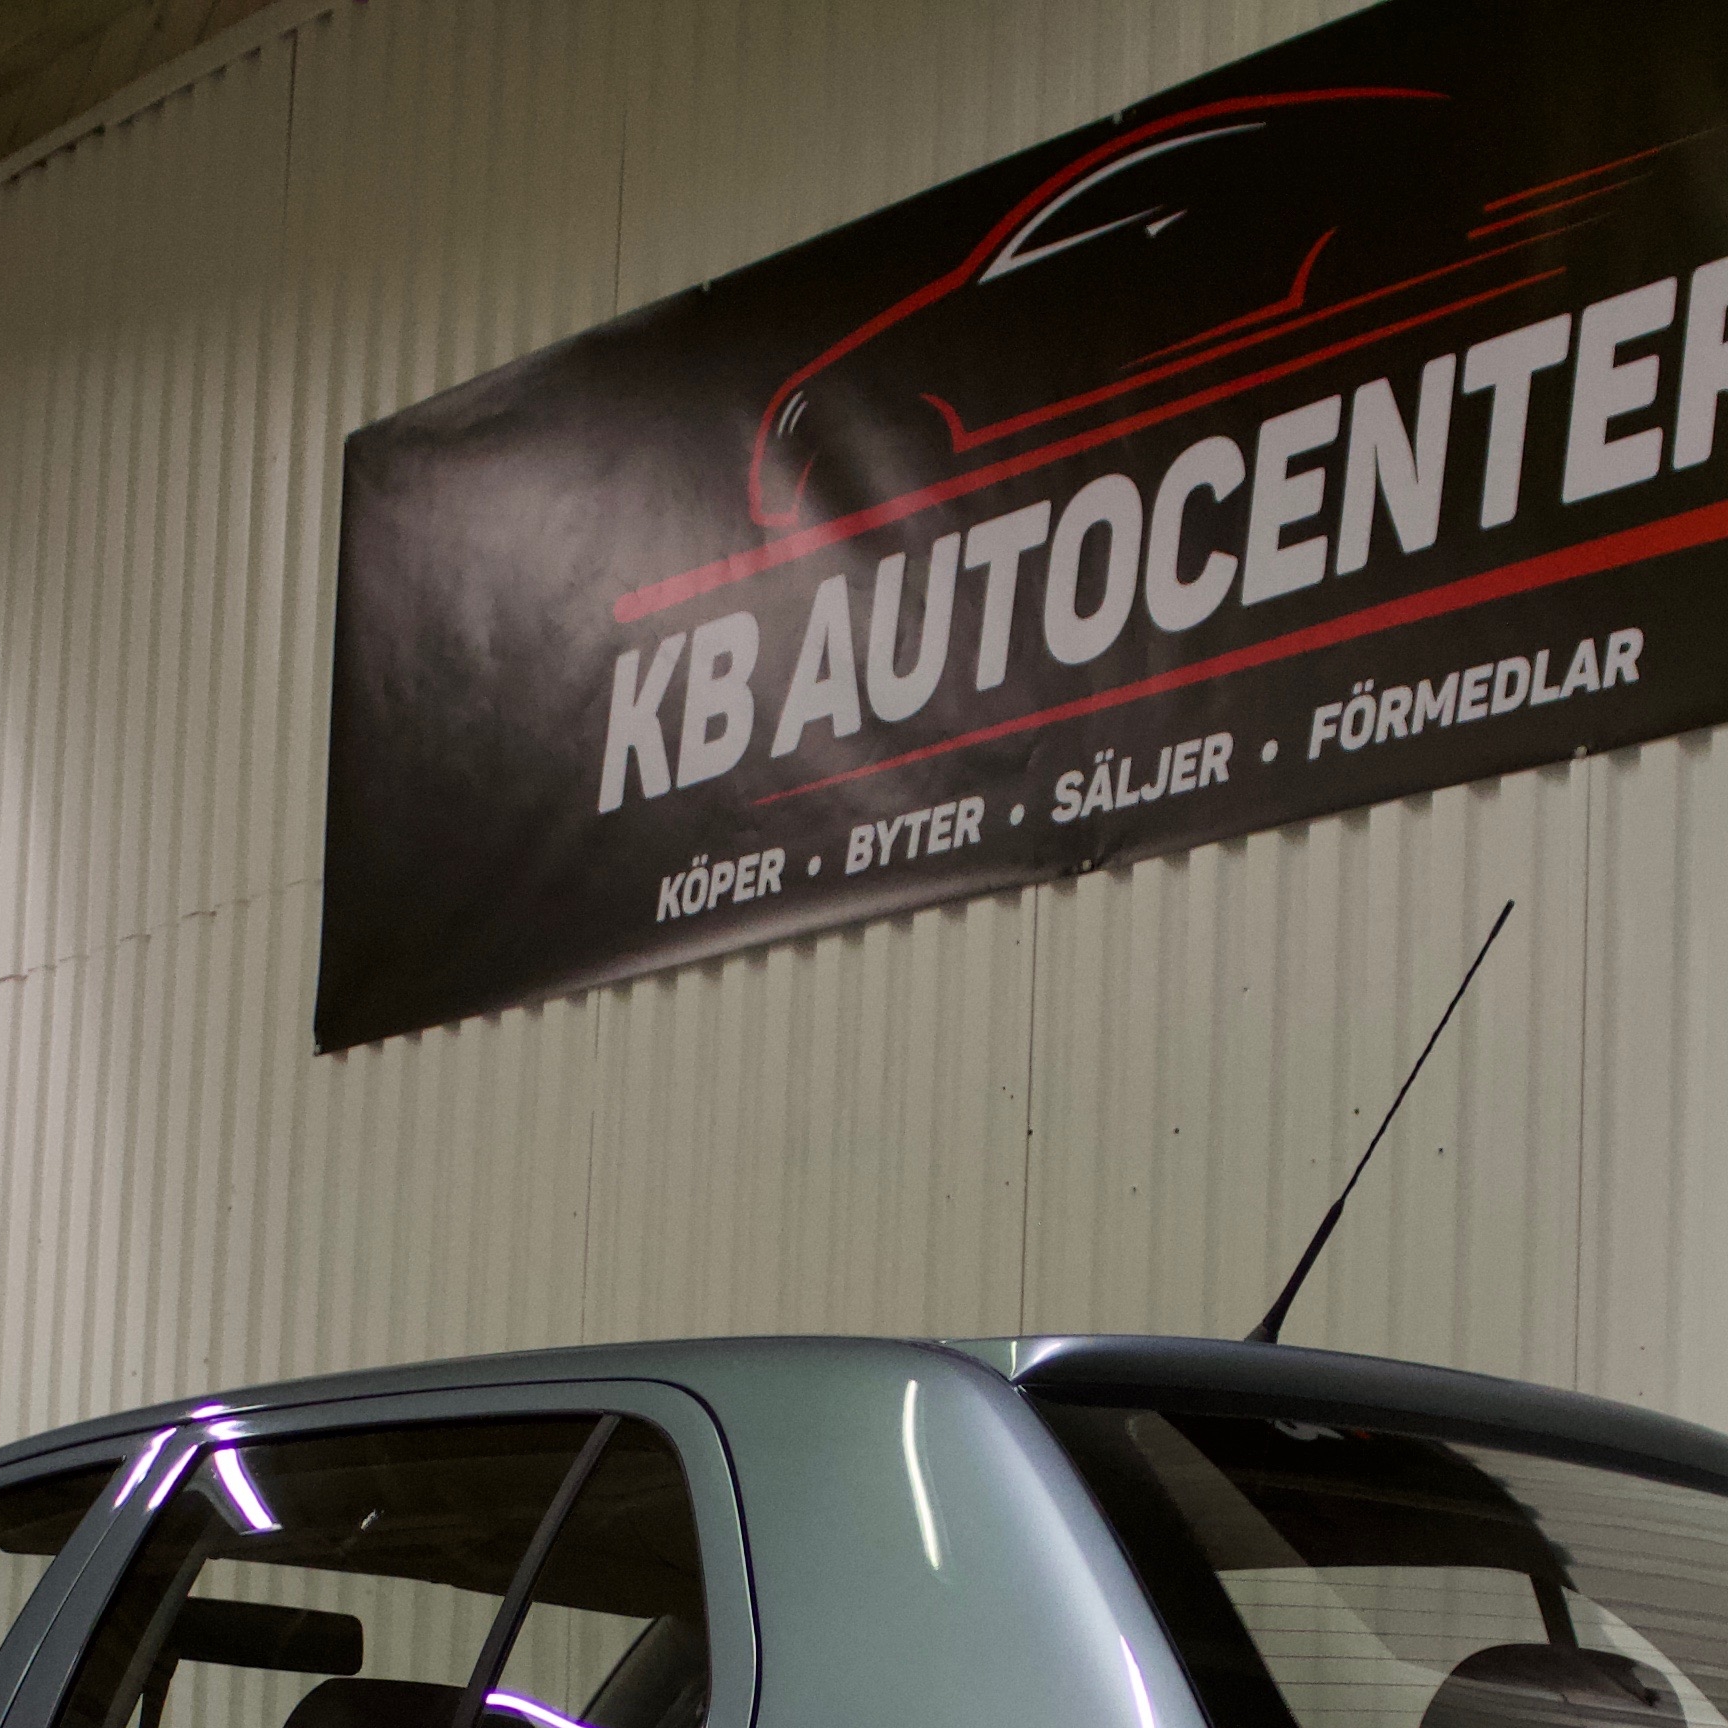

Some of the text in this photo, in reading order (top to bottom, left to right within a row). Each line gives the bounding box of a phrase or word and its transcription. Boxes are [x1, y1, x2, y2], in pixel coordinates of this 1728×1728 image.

[597, 610, 760, 815] KB
[655, 626, 1646, 923] KÖPER BYTER SÄLJER FÖRMEDLAR
